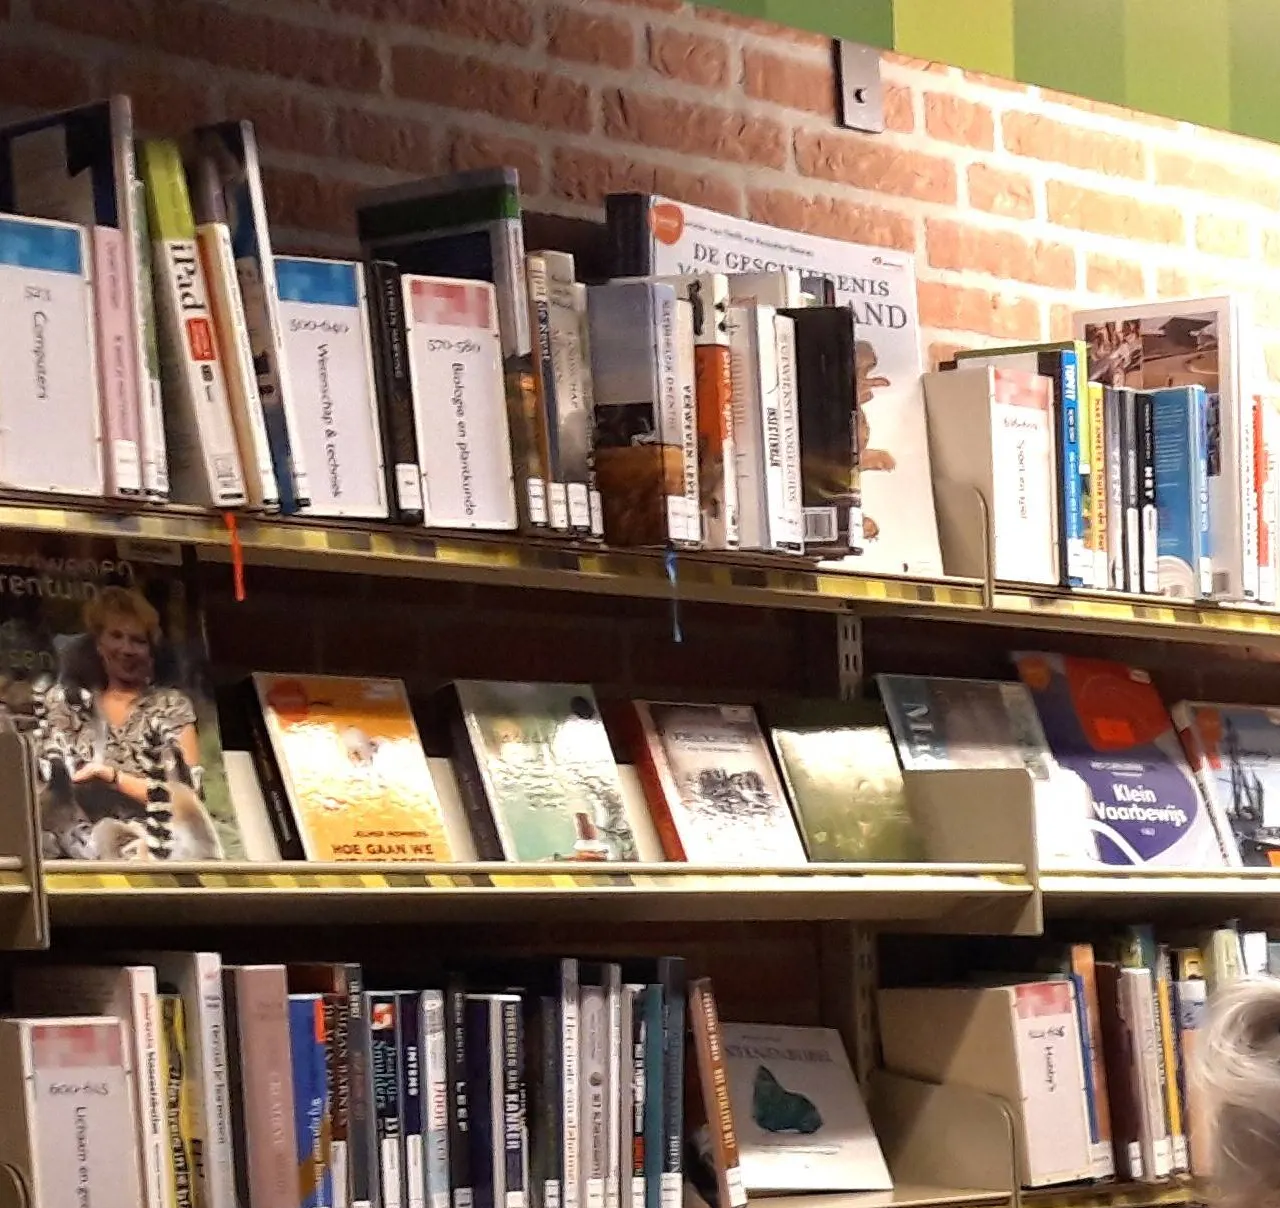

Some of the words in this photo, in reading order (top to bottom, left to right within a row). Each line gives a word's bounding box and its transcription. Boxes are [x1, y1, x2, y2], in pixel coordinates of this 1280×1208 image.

[170, 242, 207, 311] iPad
[693, 243, 719, 266] DE
[451, 362, 466, 417] Biologie
[326, 443, 343, 499] techniek
[456, 442, 476, 516] plantkunde
[1112, 783, 1157, 804] Klein
[75, 1106, 89, 1162] Lichaam
[78, 1166, 89, 1183] en
